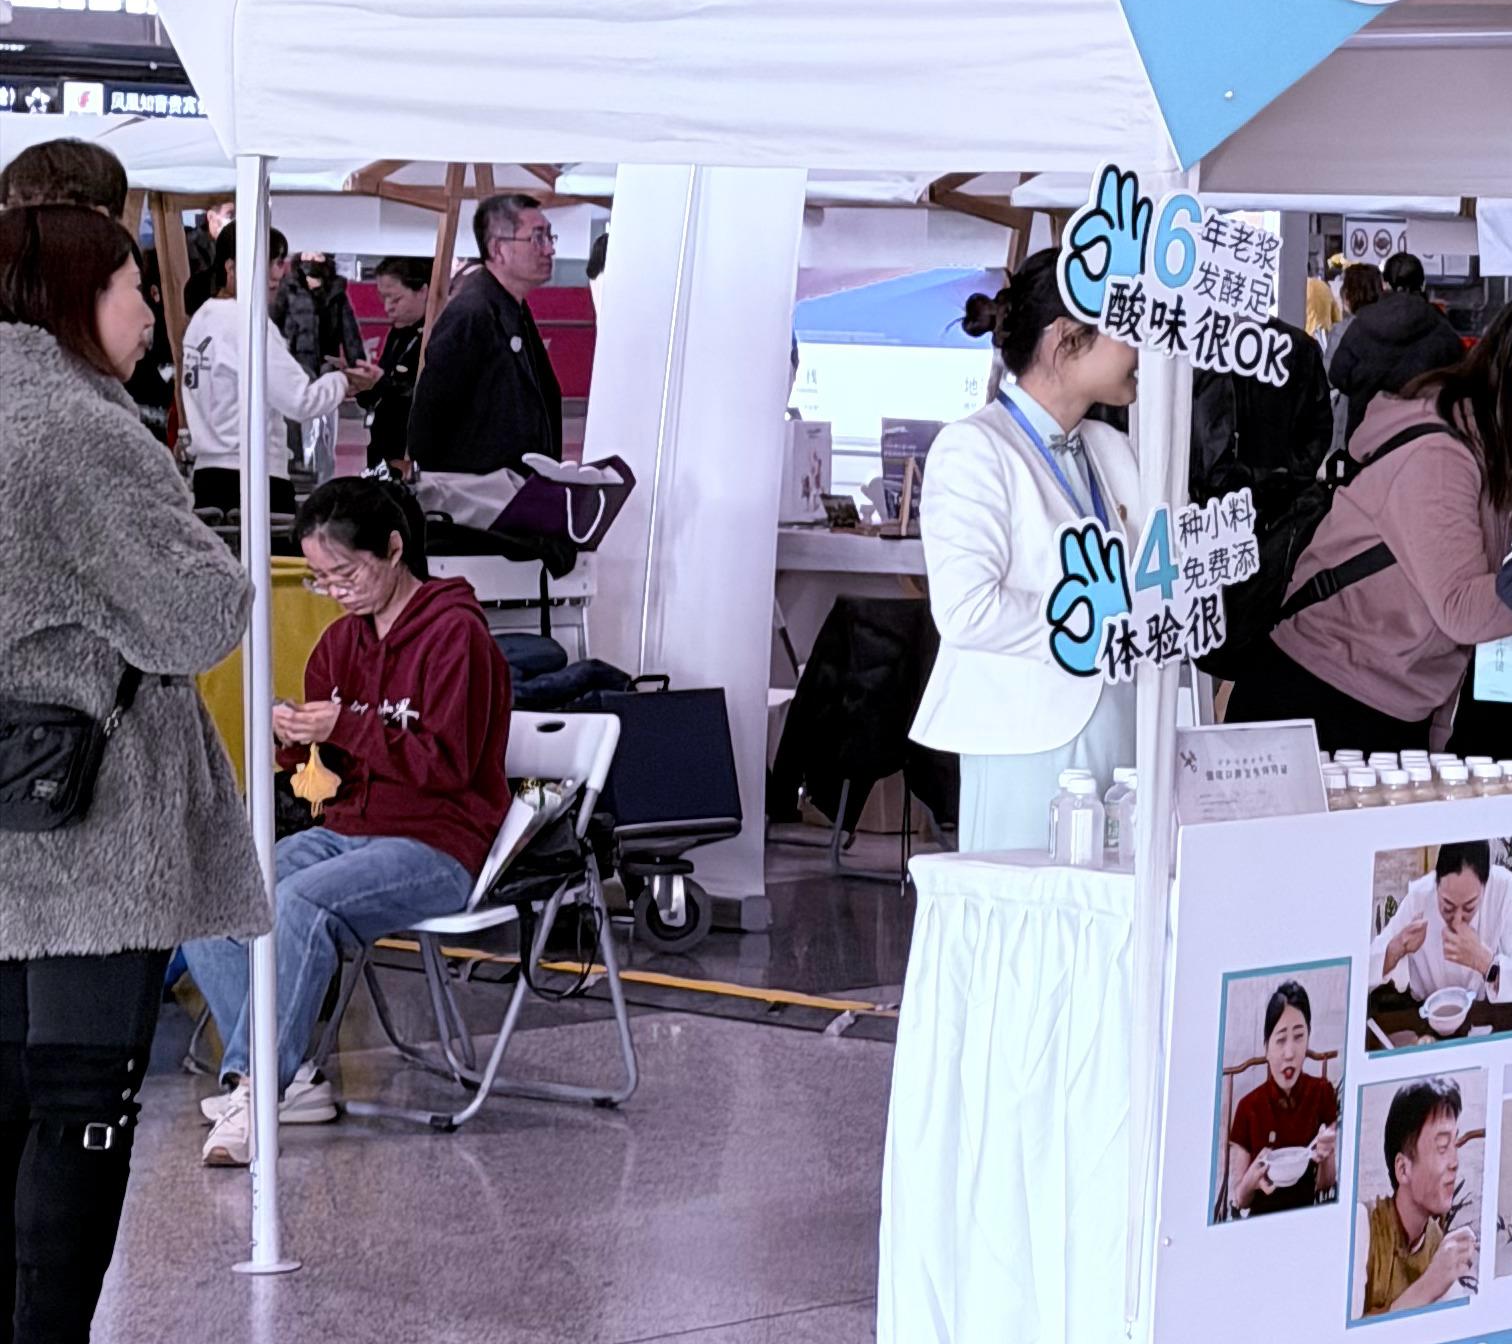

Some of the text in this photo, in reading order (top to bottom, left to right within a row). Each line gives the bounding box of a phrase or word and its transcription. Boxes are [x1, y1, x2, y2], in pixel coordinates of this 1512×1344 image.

[111, 91, 207, 115] 凤凰知音贵宾
[1154, 194, 1202, 289] 6
[1201, 214, 1279, 272] 年老浆
[1193, 261, 1275, 319] 发酵足
[1105, 281, 1292, 381] 酸味很OK
[1179, 493, 1253, 547] 种小料
[1135, 507, 1179, 600] 4
[1183, 540, 1258, 594] 免费添
[1101, 593, 1224, 679] 体验很
